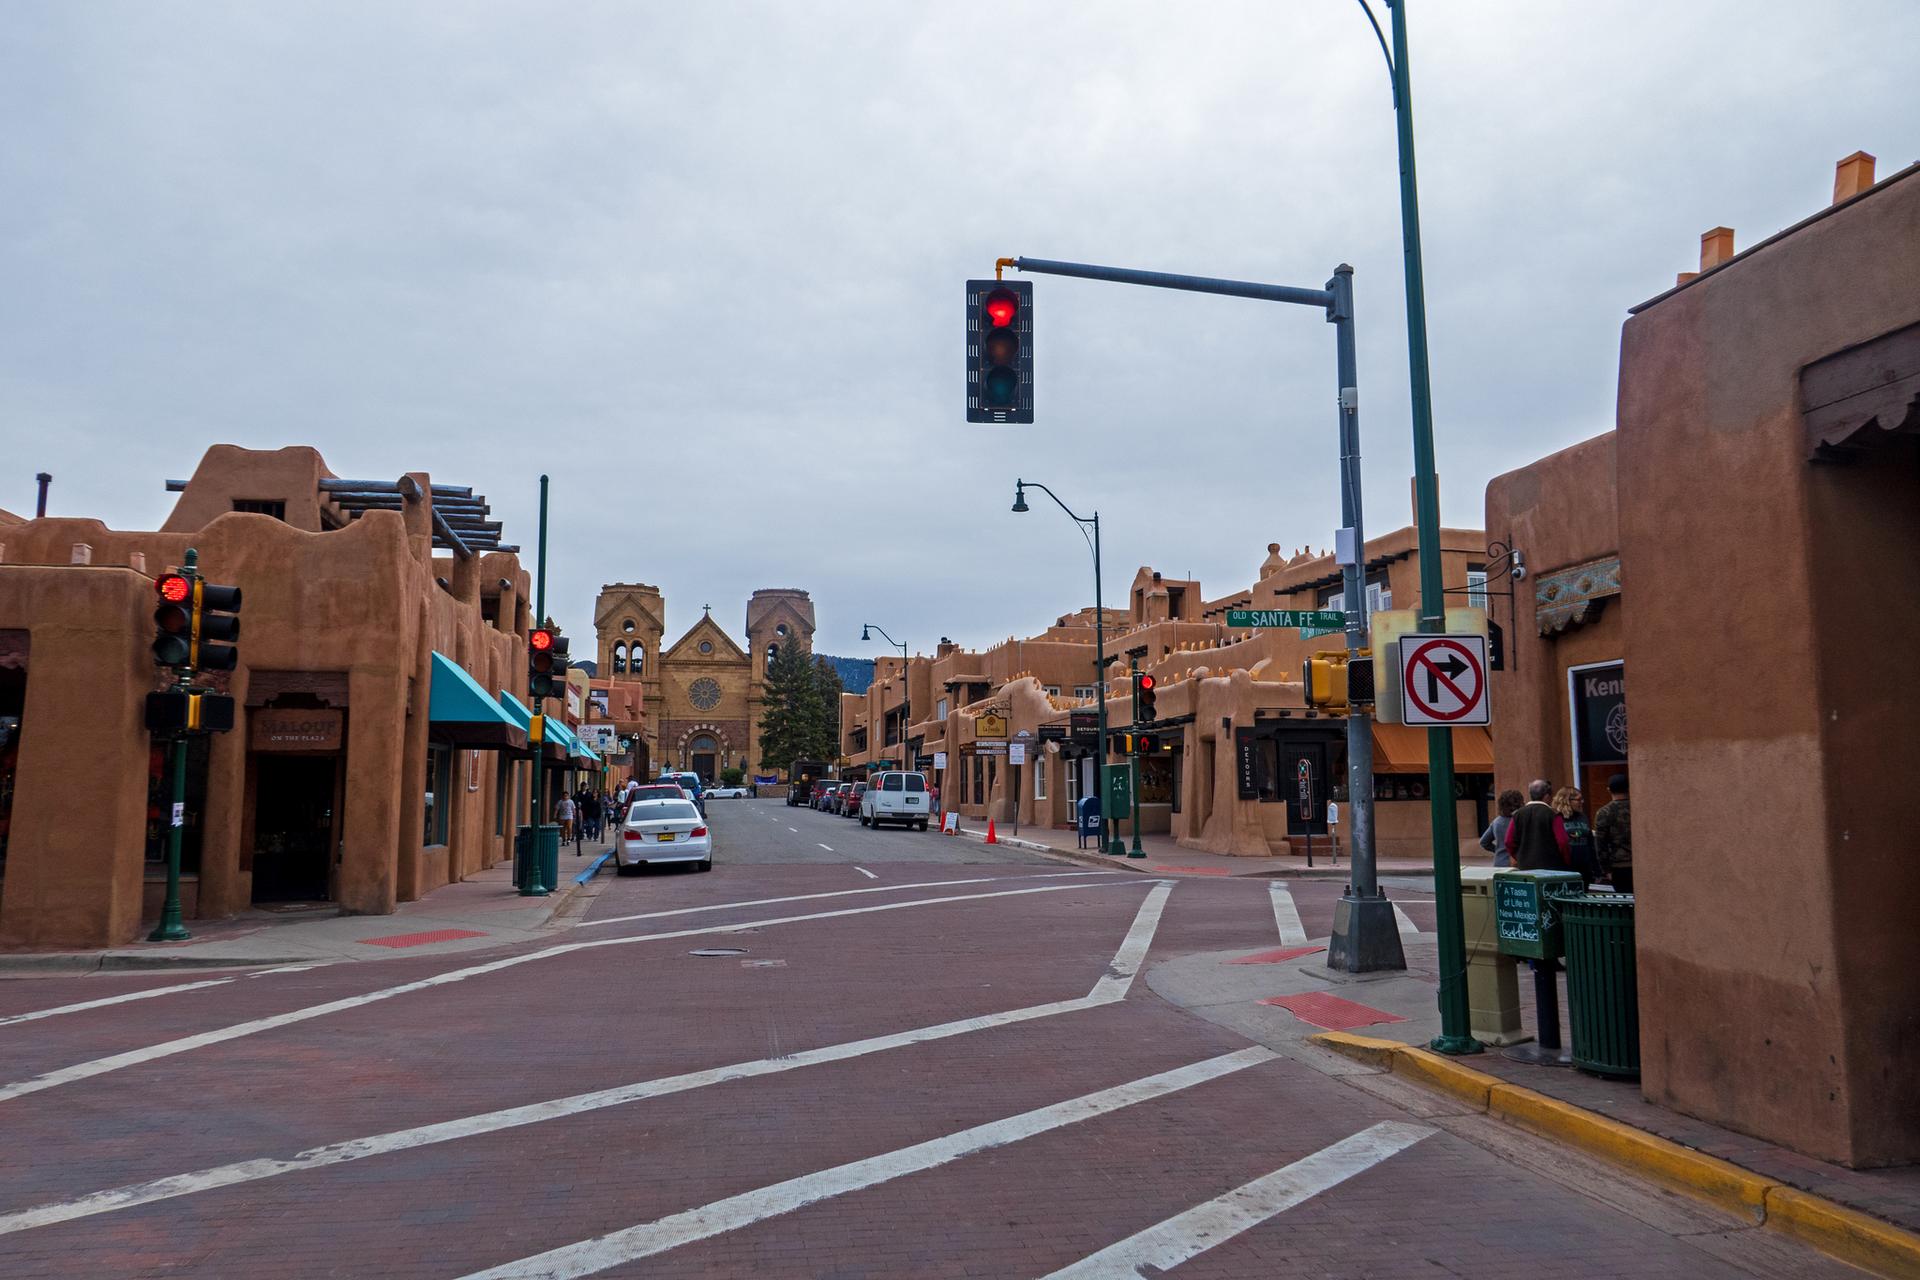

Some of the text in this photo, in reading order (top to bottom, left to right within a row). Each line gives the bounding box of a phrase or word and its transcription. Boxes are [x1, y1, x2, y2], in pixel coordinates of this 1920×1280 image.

[1232, 611, 1338, 627] OLD SANTA FE TRAIL
[1503, 887, 1528, 897] A Taste
[1503, 899, 1530, 908] of Life in
[1499, 909, 1537, 920] New Mexico
